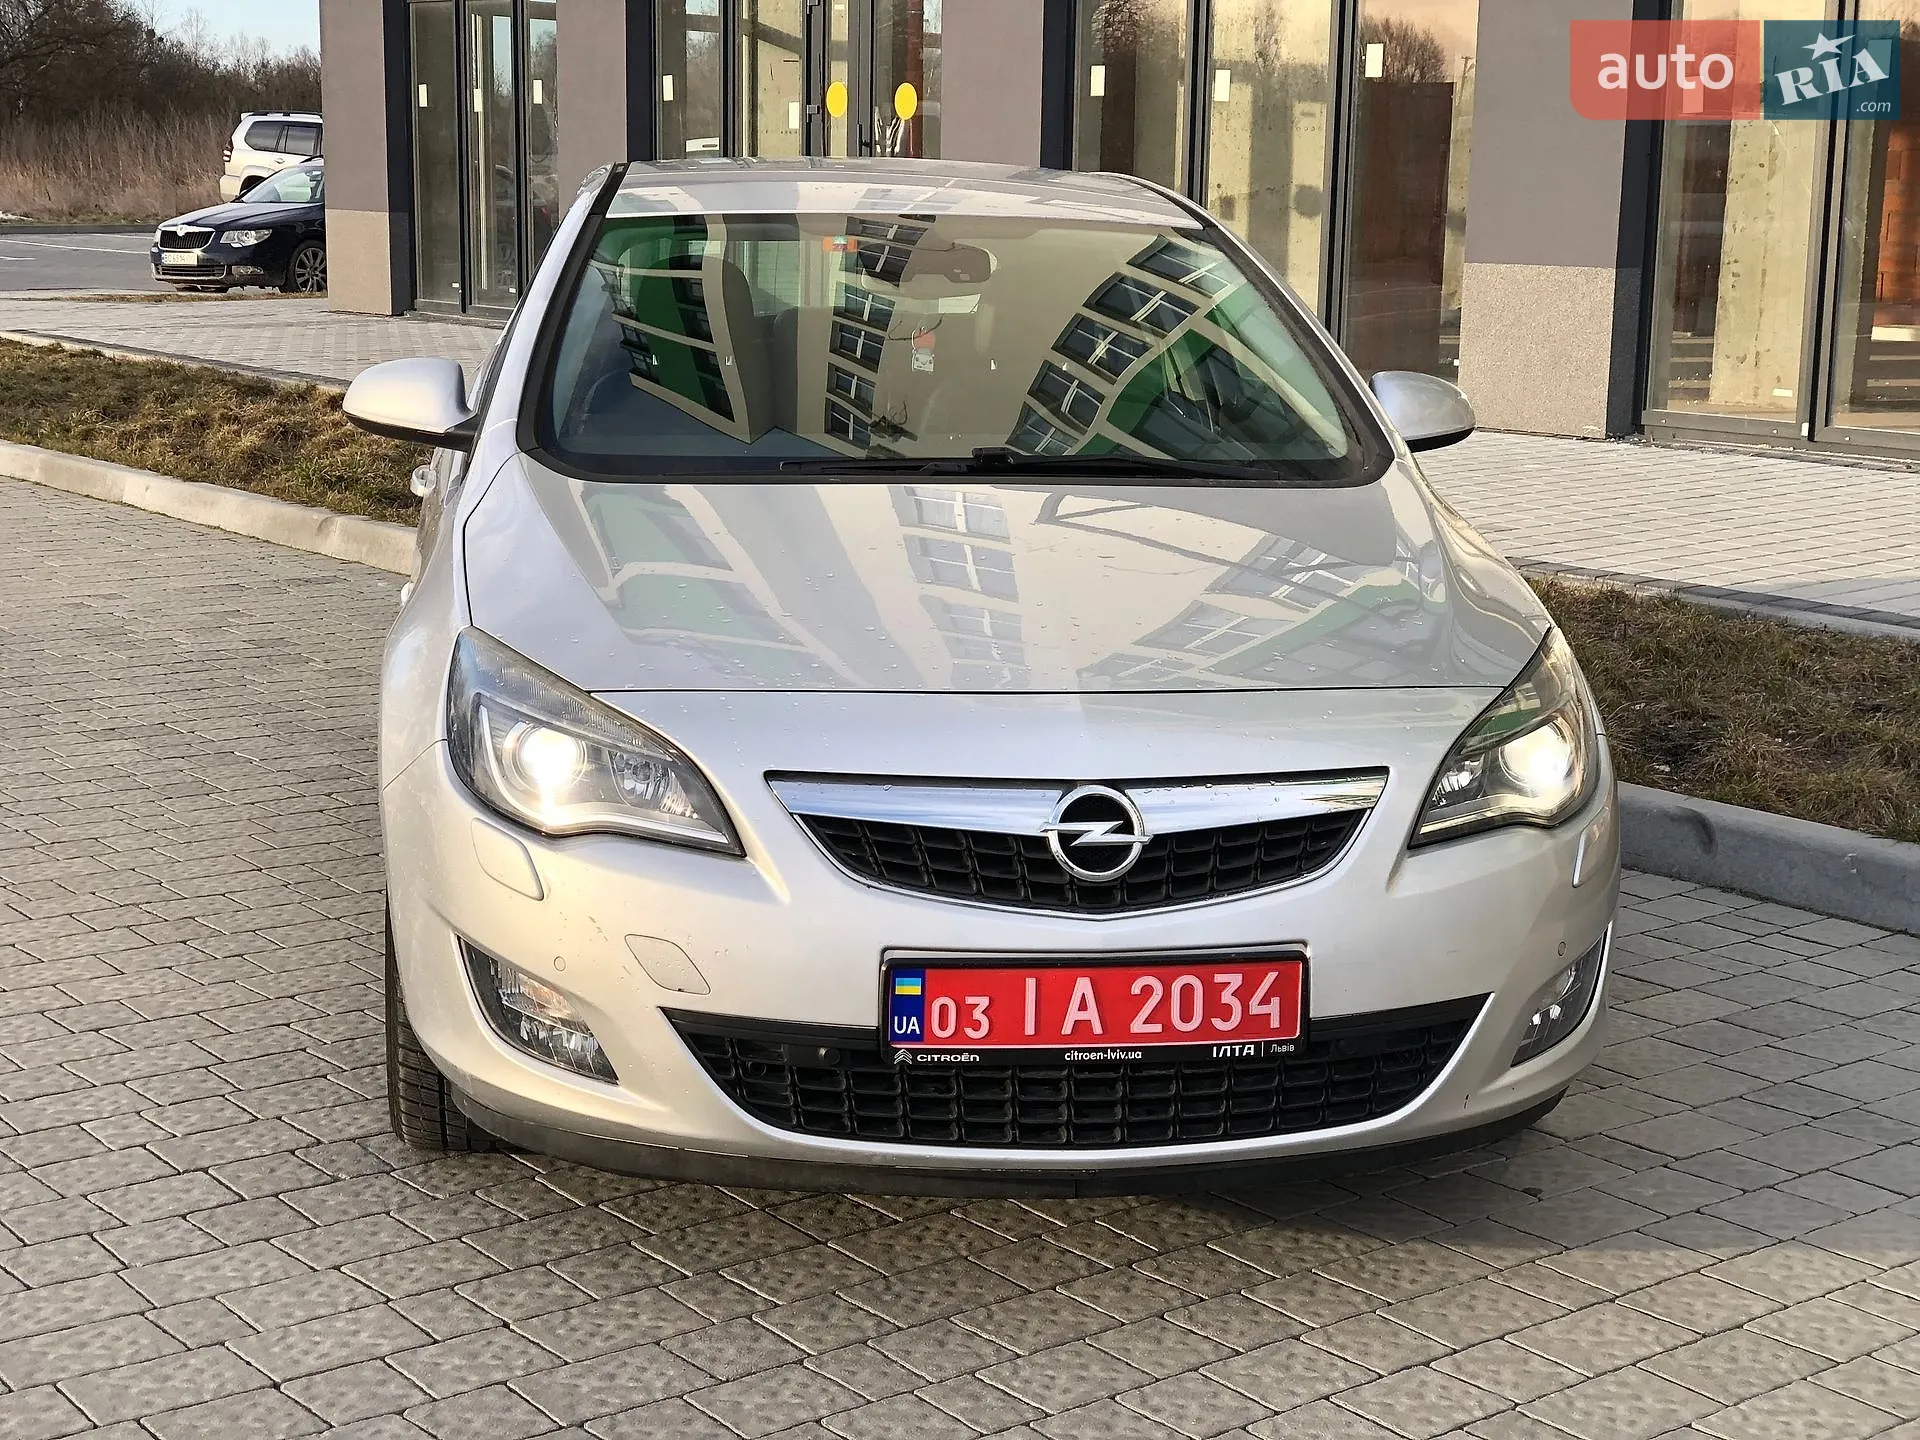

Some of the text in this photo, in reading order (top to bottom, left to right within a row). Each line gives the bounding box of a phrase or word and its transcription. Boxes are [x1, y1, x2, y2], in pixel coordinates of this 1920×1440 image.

[930, 996, 992, 1040] 03
[1129, 971, 1281, 1034] 2034
[894, 1016, 921, 1035] UA
[1064, 1049, 1142, 1062] citroen-lviv.ua
[1270, 1043, 1295, 1053] Львів
